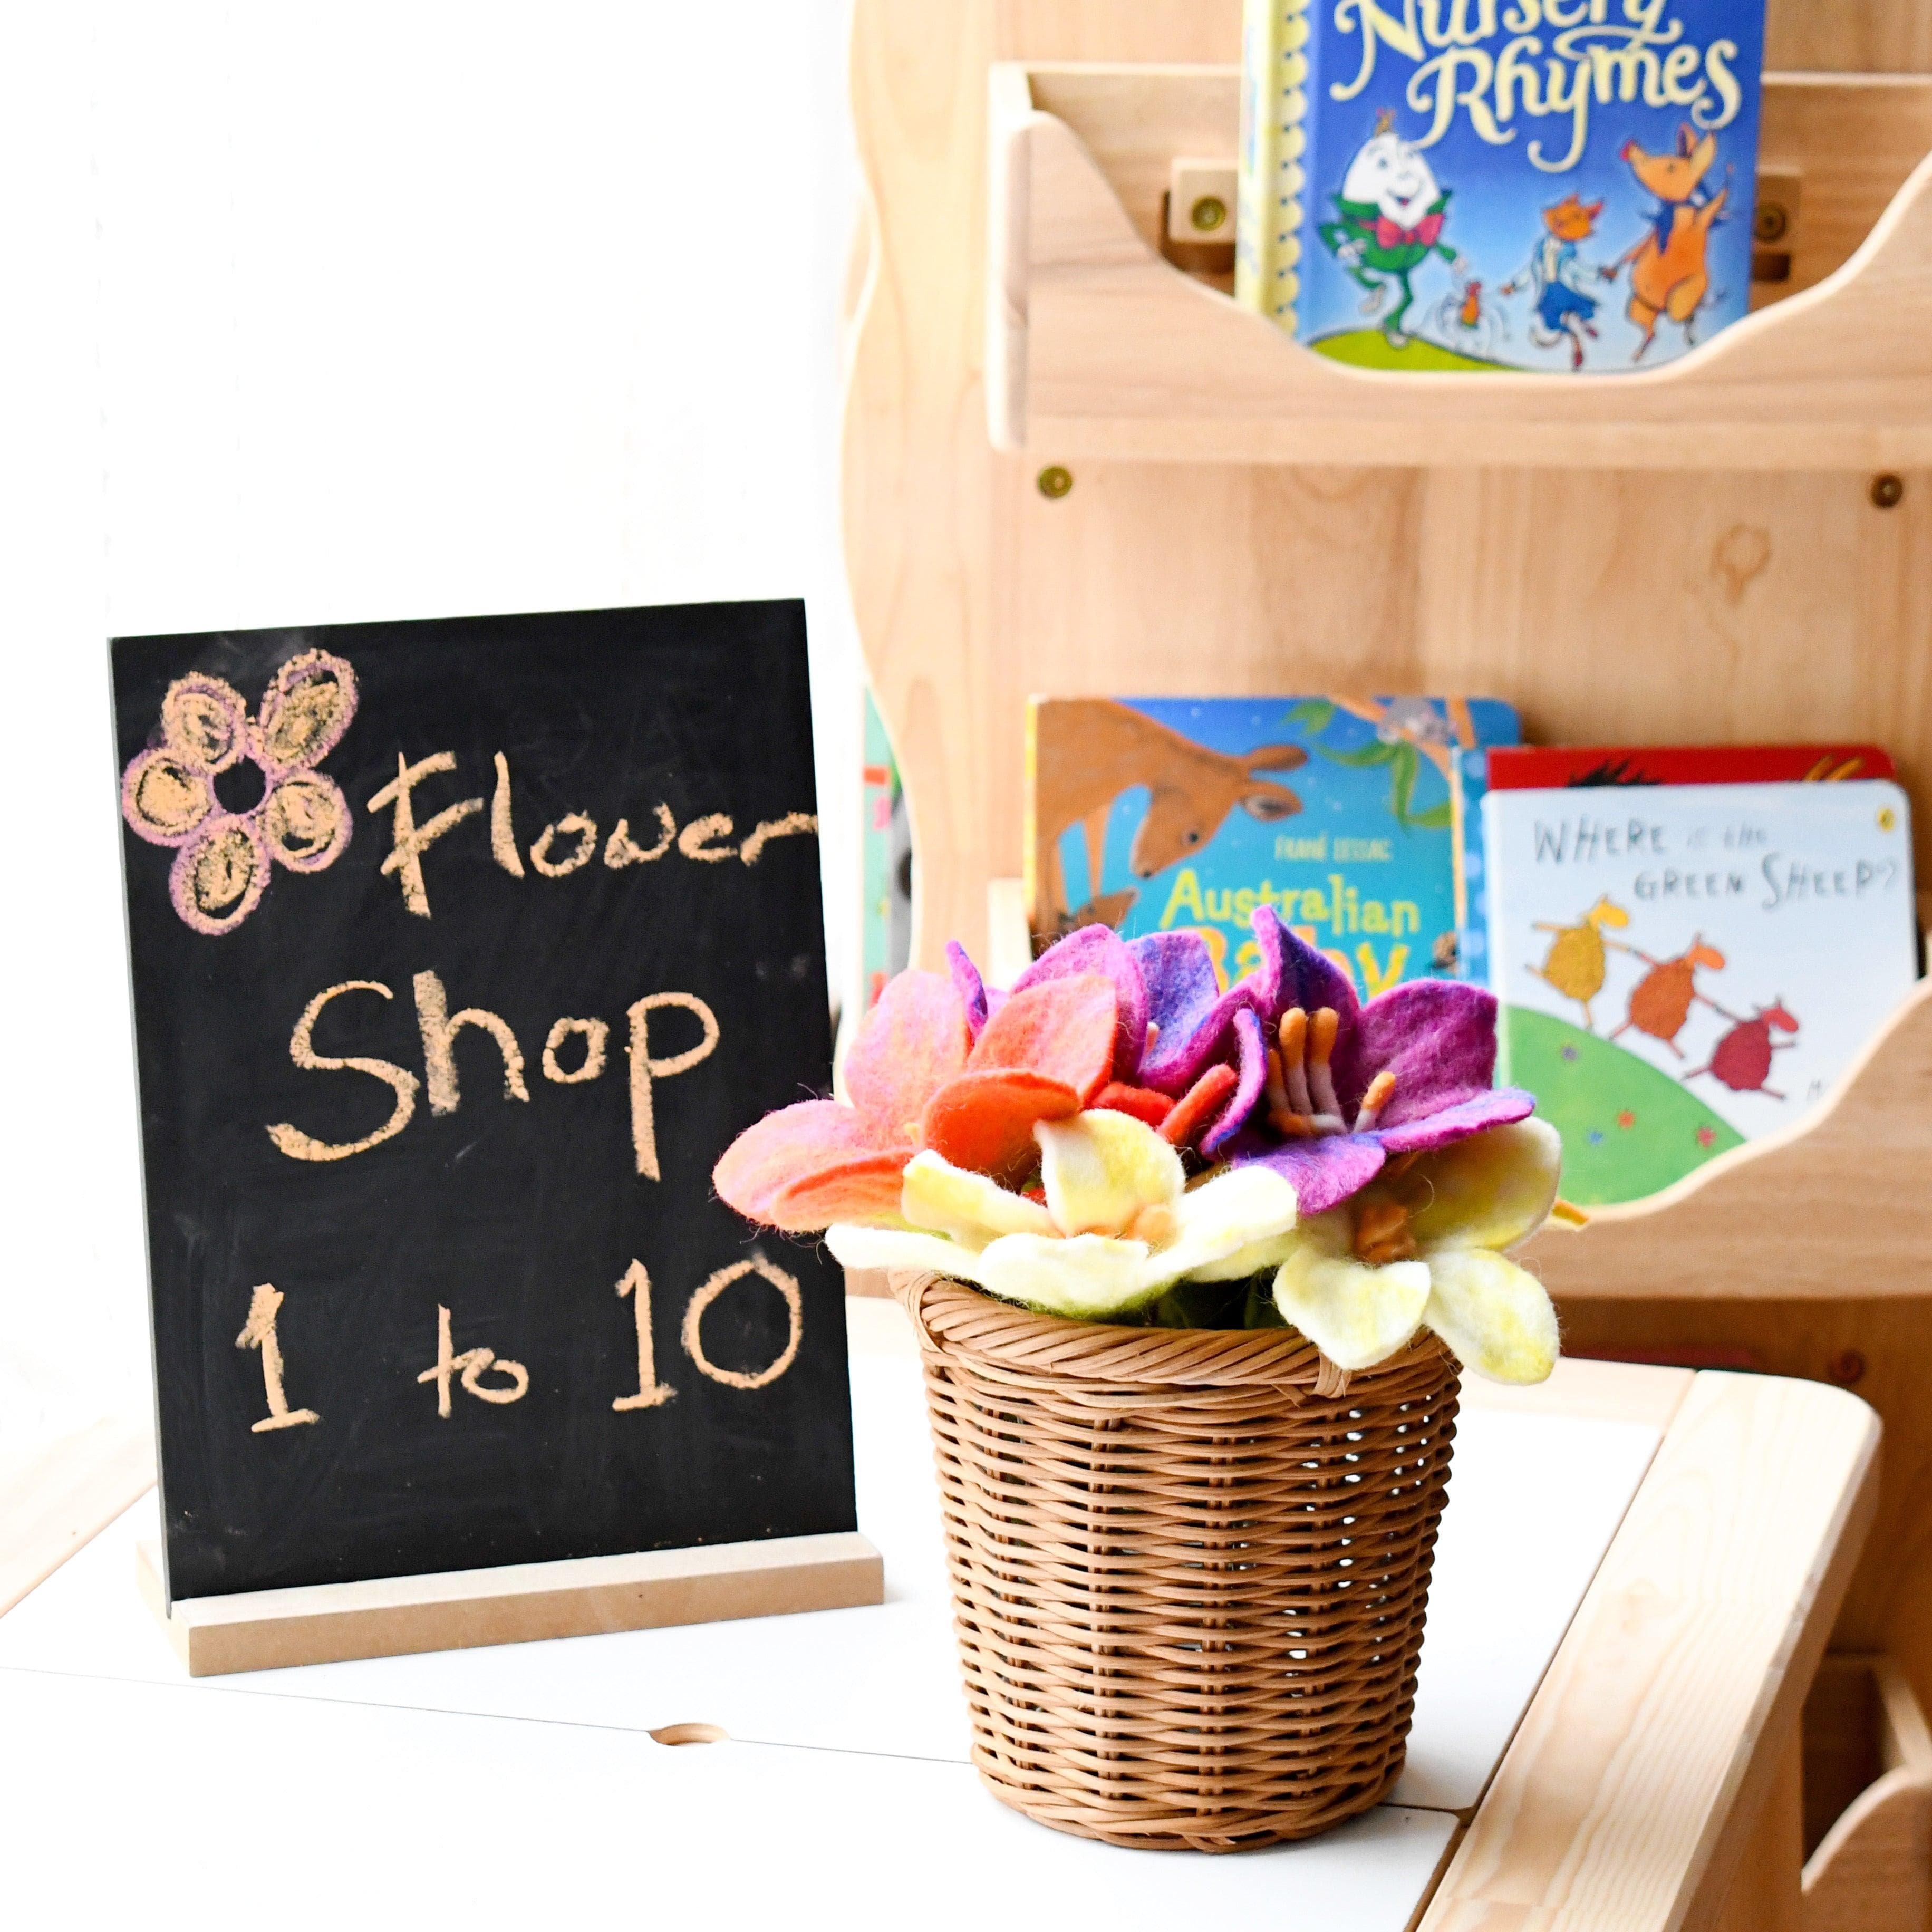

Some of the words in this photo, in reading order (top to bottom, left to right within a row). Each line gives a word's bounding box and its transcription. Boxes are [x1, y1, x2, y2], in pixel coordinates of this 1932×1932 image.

[1406, 35, 1741, 172] Rhymes
[366, 750, 819, 918] Flower
[1160, 868, 1421, 937] Australian
[1534, 813, 1666, 864] WHERE
[1634, 868, 1744, 900] GREEN
[1761, 851, 1898, 911] SHEEP?
[266, 970, 720, 1181] Shop
[236, 1283, 318, 1432] 1
[417, 1303, 529, 1417] to
[612, 1254, 803, 1411] 10
